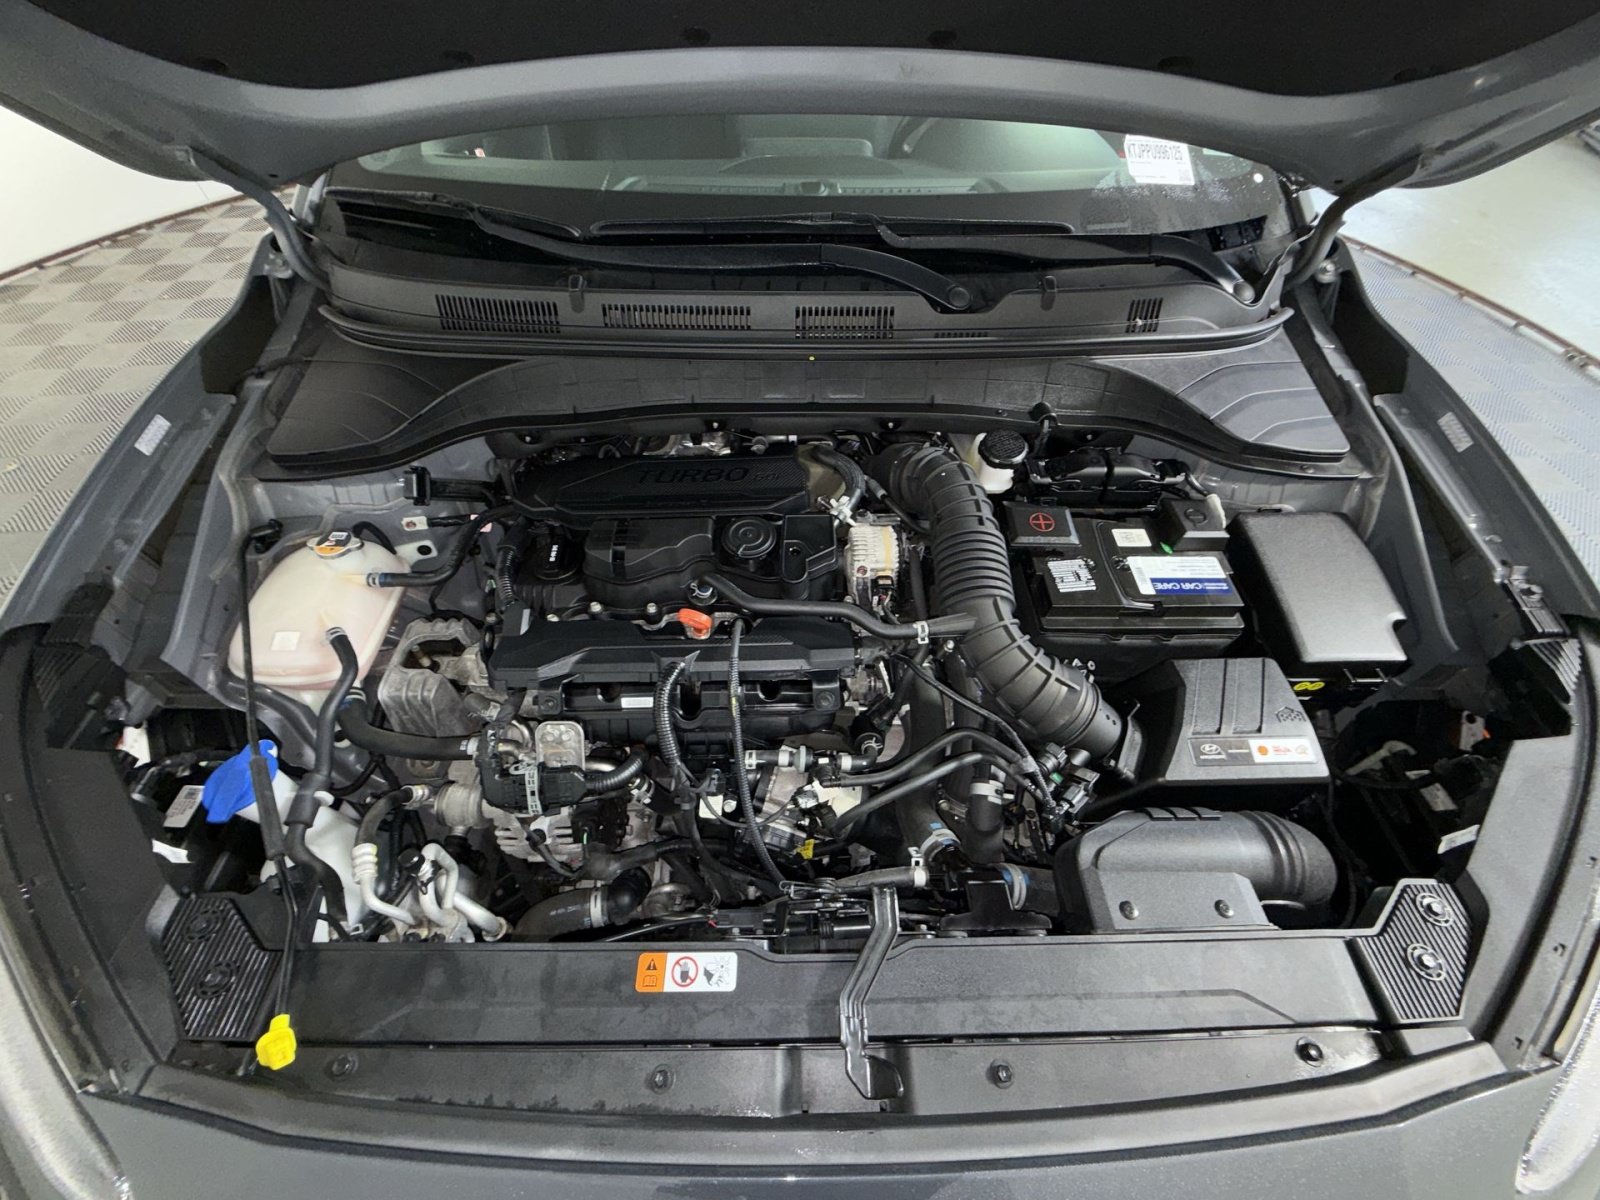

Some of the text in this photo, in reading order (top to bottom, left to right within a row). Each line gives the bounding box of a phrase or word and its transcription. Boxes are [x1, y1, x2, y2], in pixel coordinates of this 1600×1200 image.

[638, 467, 750, 484] TURBO
[1153, 582, 1180, 590] CARE
[1180, 582, 1203, 590] CAR
